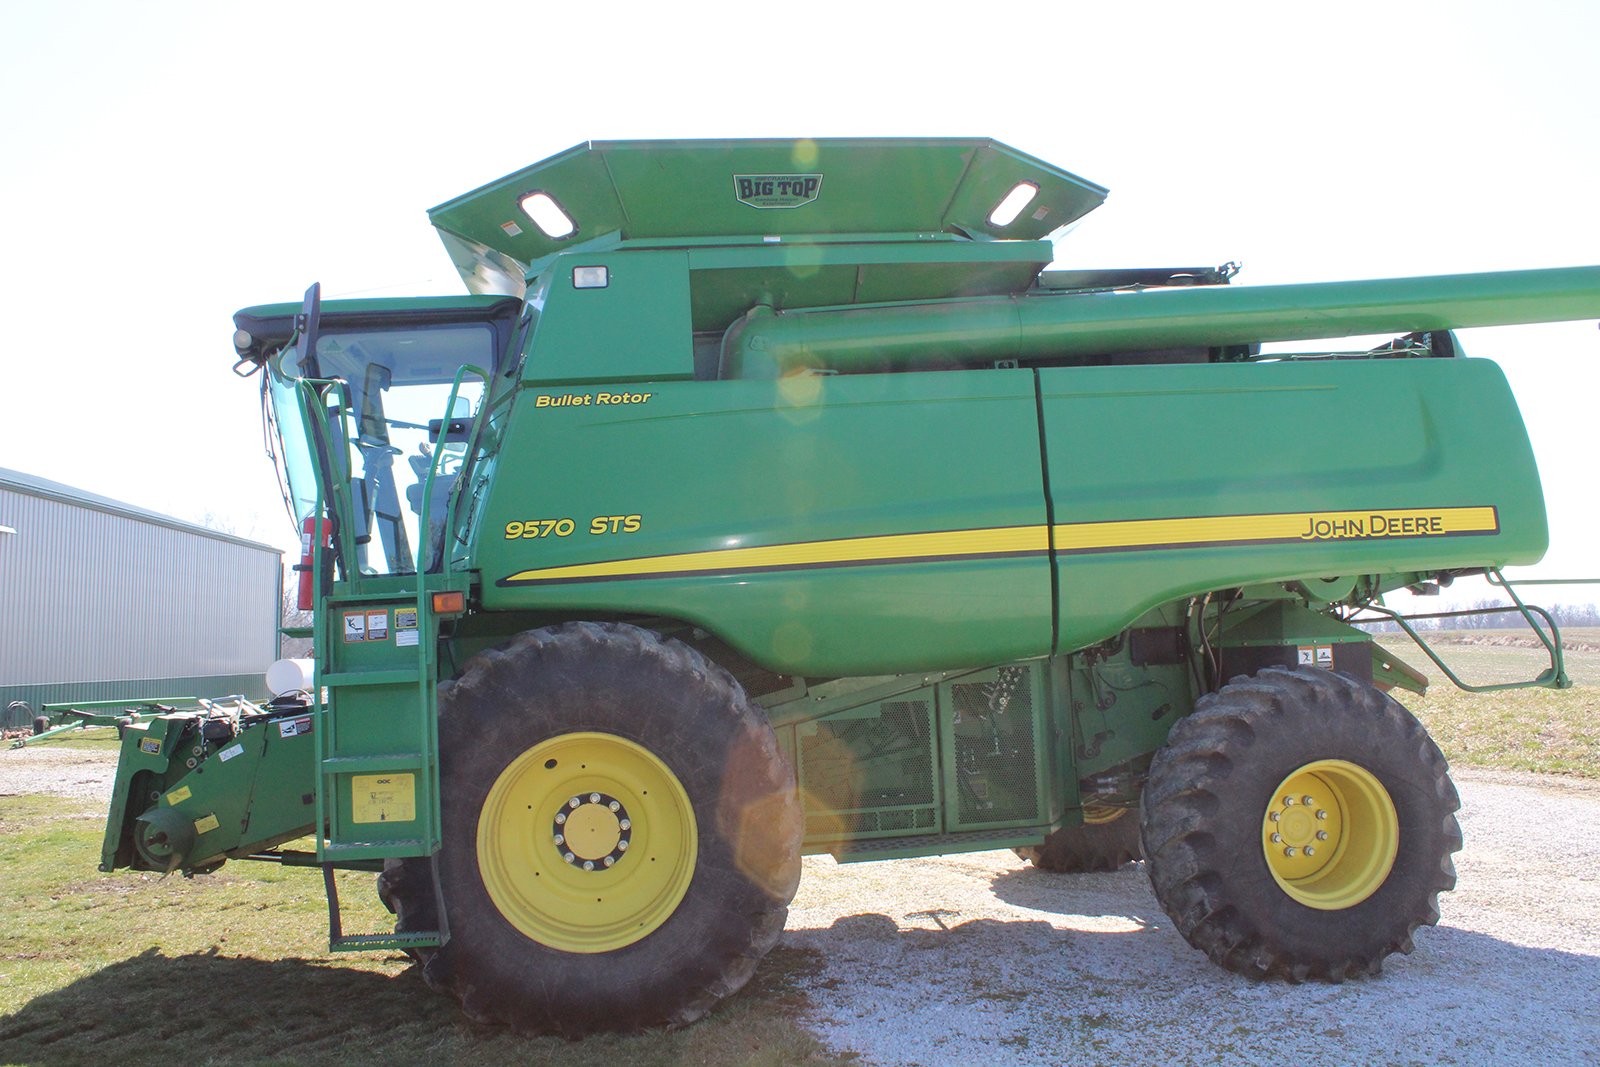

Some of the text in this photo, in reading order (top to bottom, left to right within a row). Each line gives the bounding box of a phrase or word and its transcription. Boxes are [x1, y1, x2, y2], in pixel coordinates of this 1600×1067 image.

[739, 178, 818, 200] BIG TOP
[535, 392, 652, 408] Bullet Rotor
[504, 514, 642, 540] 9570 STS
[1301, 514, 1442, 537] JOHN DEERE
